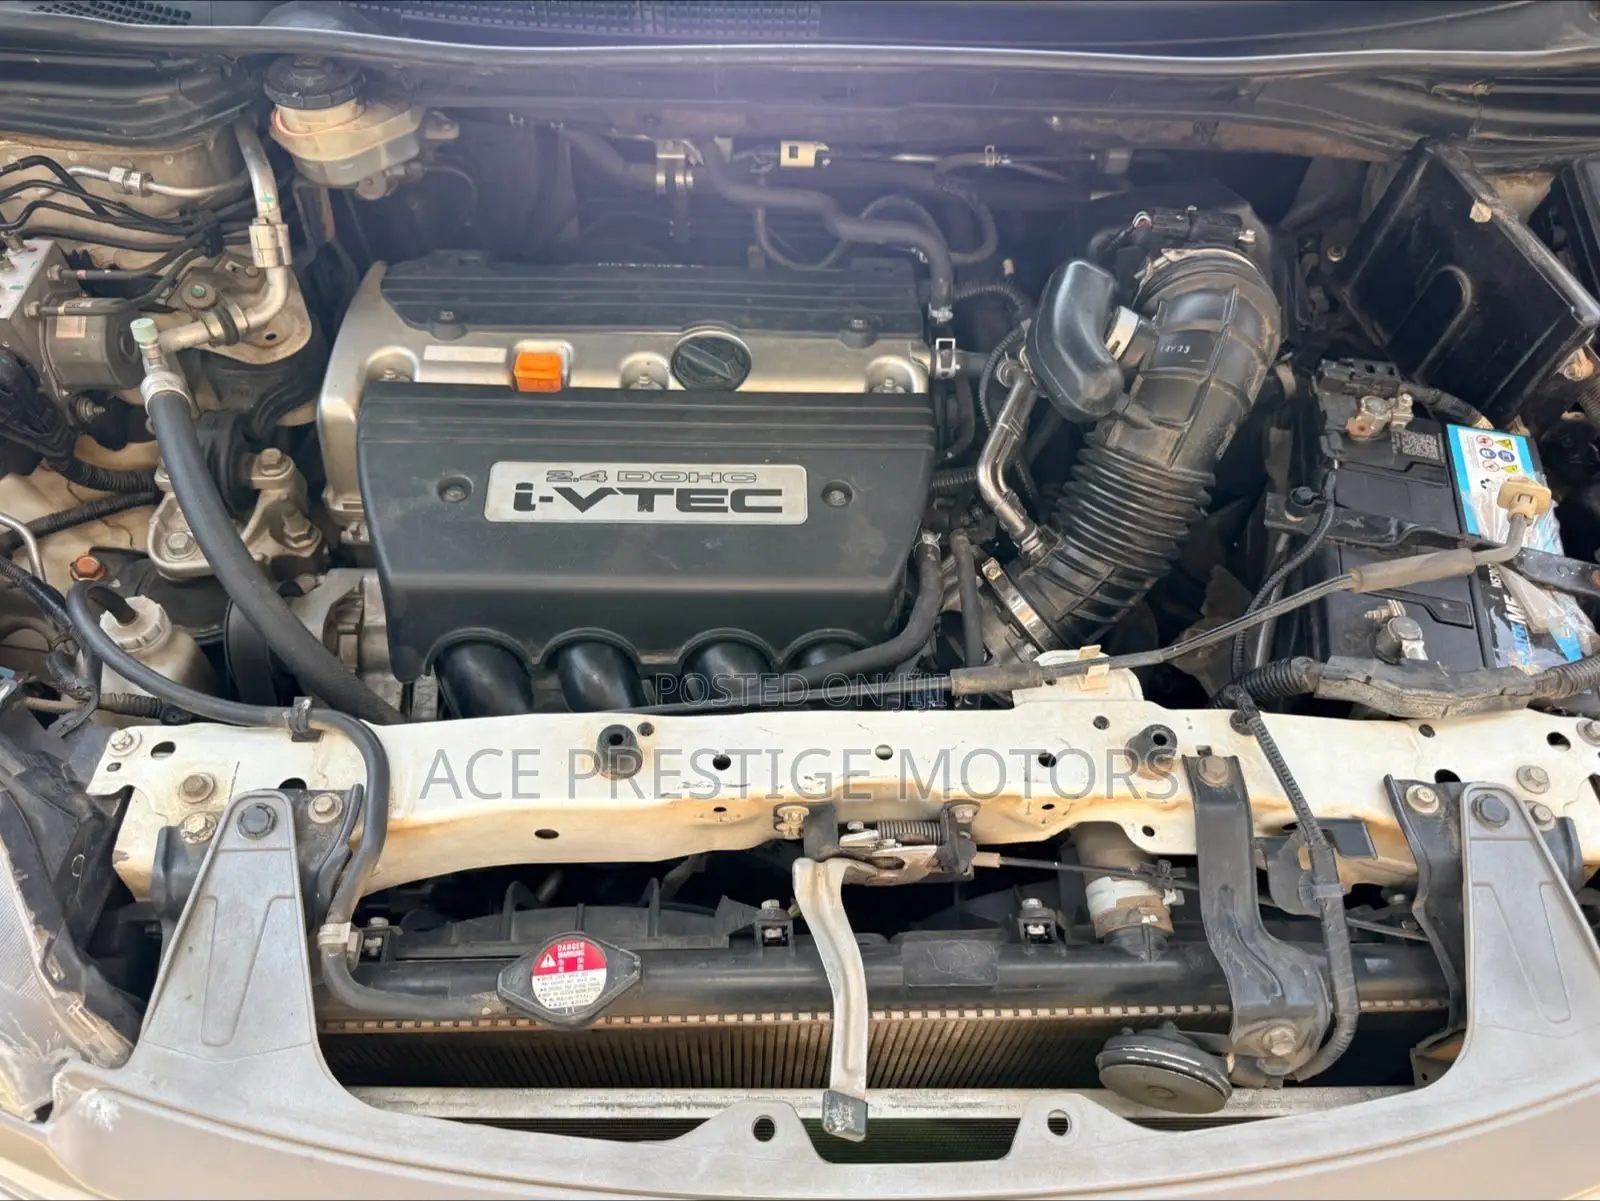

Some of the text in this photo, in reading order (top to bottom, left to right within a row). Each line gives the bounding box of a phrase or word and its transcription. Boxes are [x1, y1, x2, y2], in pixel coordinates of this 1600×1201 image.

[546, 470, 757, 484] 2.4 DOHC
[513, 482, 783, 513] i-VTEC
[557, 941, 585, 952] DANGER
